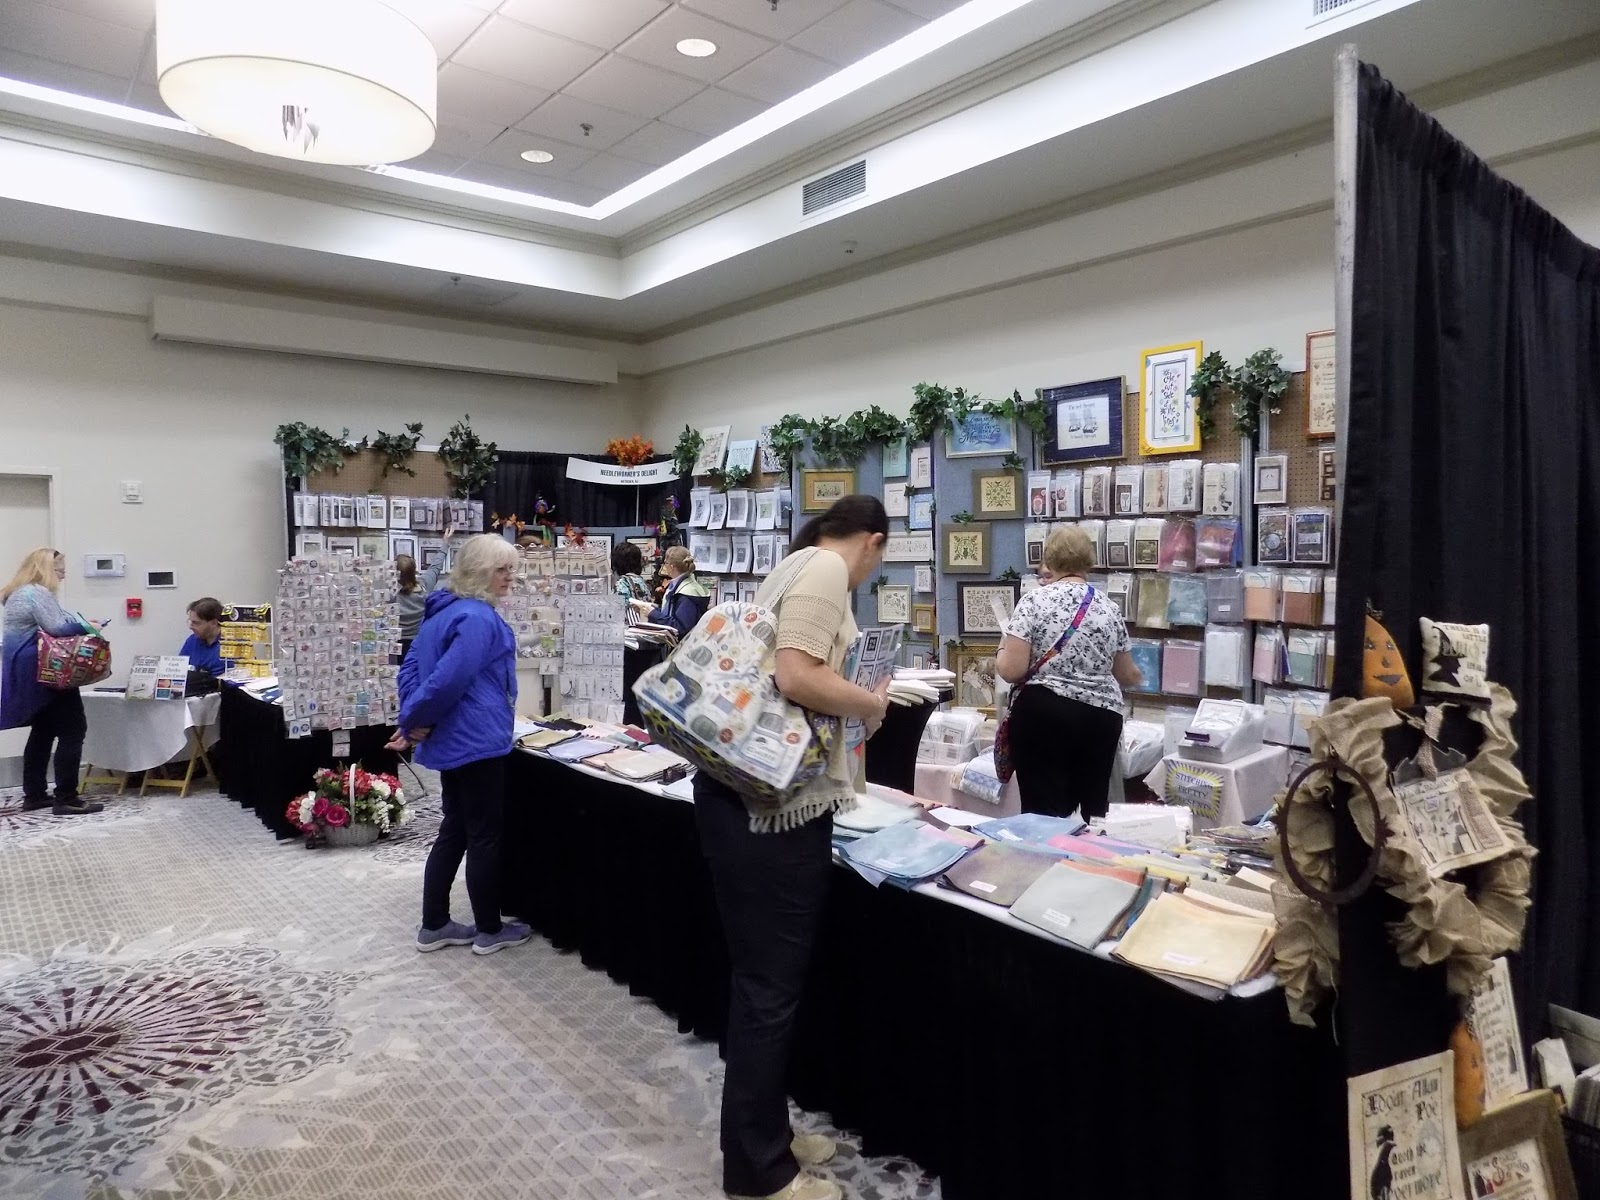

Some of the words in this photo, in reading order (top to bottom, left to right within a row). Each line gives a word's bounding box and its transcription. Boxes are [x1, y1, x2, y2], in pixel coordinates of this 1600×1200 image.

[600, 469, 641, 478] NEEDLEWORKER'S
[641, 468, 658, 477] DELIGHT
[1175, 772, 1213, 790] STITCHING
[1178, 784, 1209, 798] PRETTY
